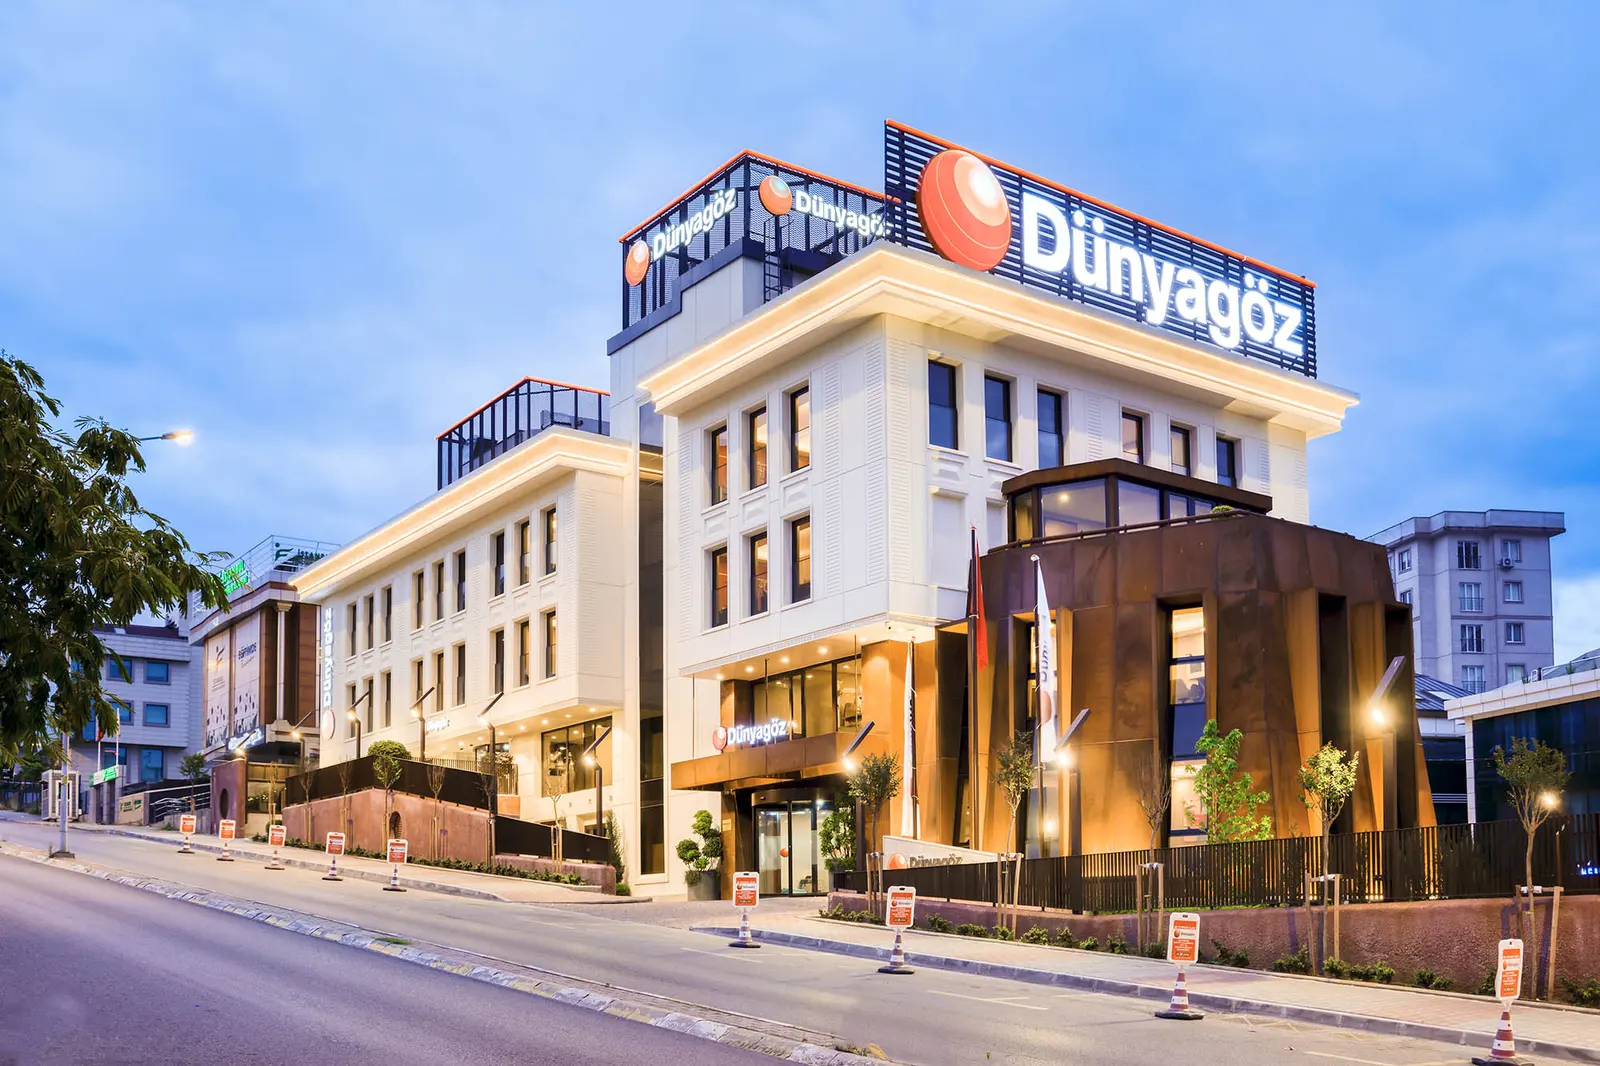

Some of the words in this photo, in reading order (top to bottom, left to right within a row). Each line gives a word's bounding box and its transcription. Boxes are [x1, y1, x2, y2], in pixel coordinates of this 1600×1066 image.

[653, 188, 738, 259] Dünyagöz
[1022, 191, 1303, 356] Dünyagöz
[727, 717, 787, 744] Dünyagöz
